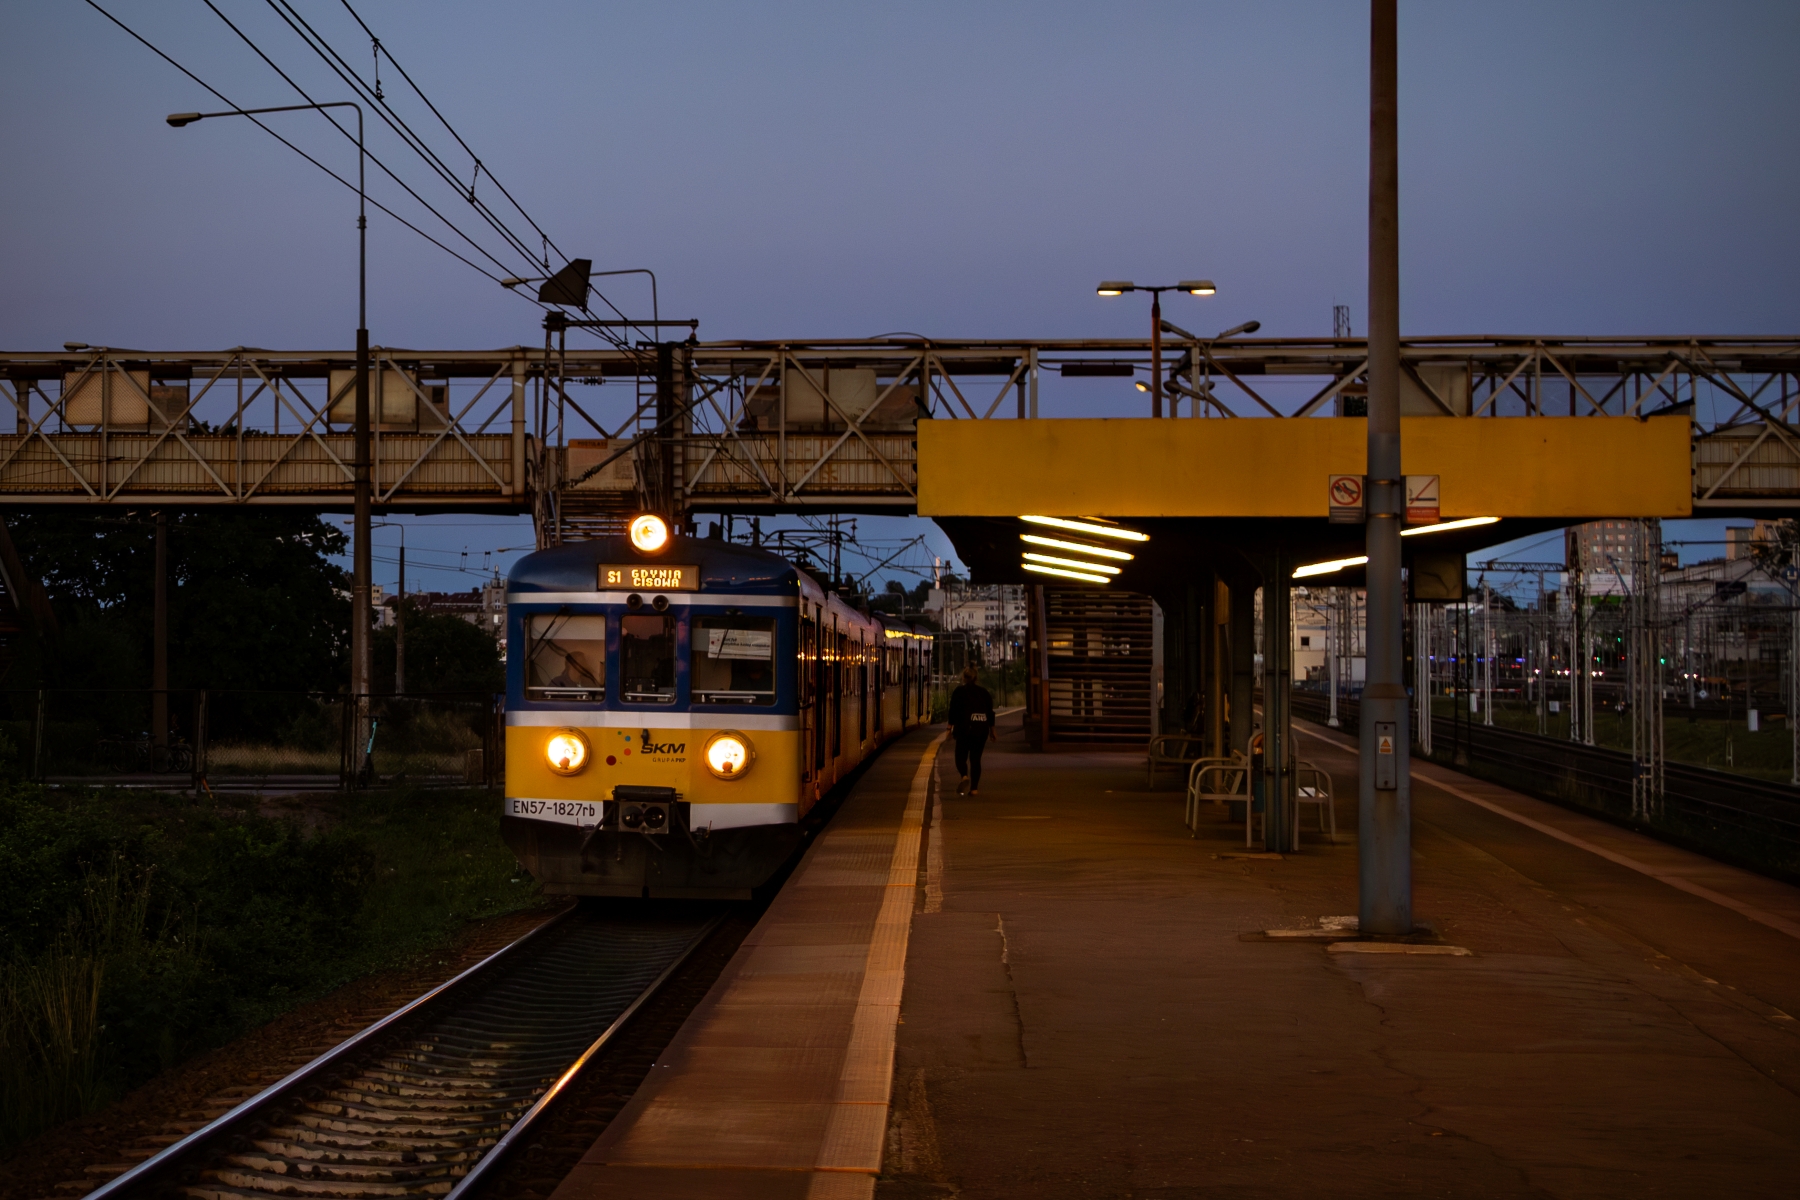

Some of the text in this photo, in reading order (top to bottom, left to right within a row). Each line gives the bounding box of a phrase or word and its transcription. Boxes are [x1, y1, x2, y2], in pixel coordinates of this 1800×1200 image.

[607, 570, 621, 583] S1
[631, 569, 682, 579] GDYNIA
[633, 577, 679, 587] CISOWA
[640, 743, 686, 754] SKM
[513, 800, 595, 817] EN57-1827rb
